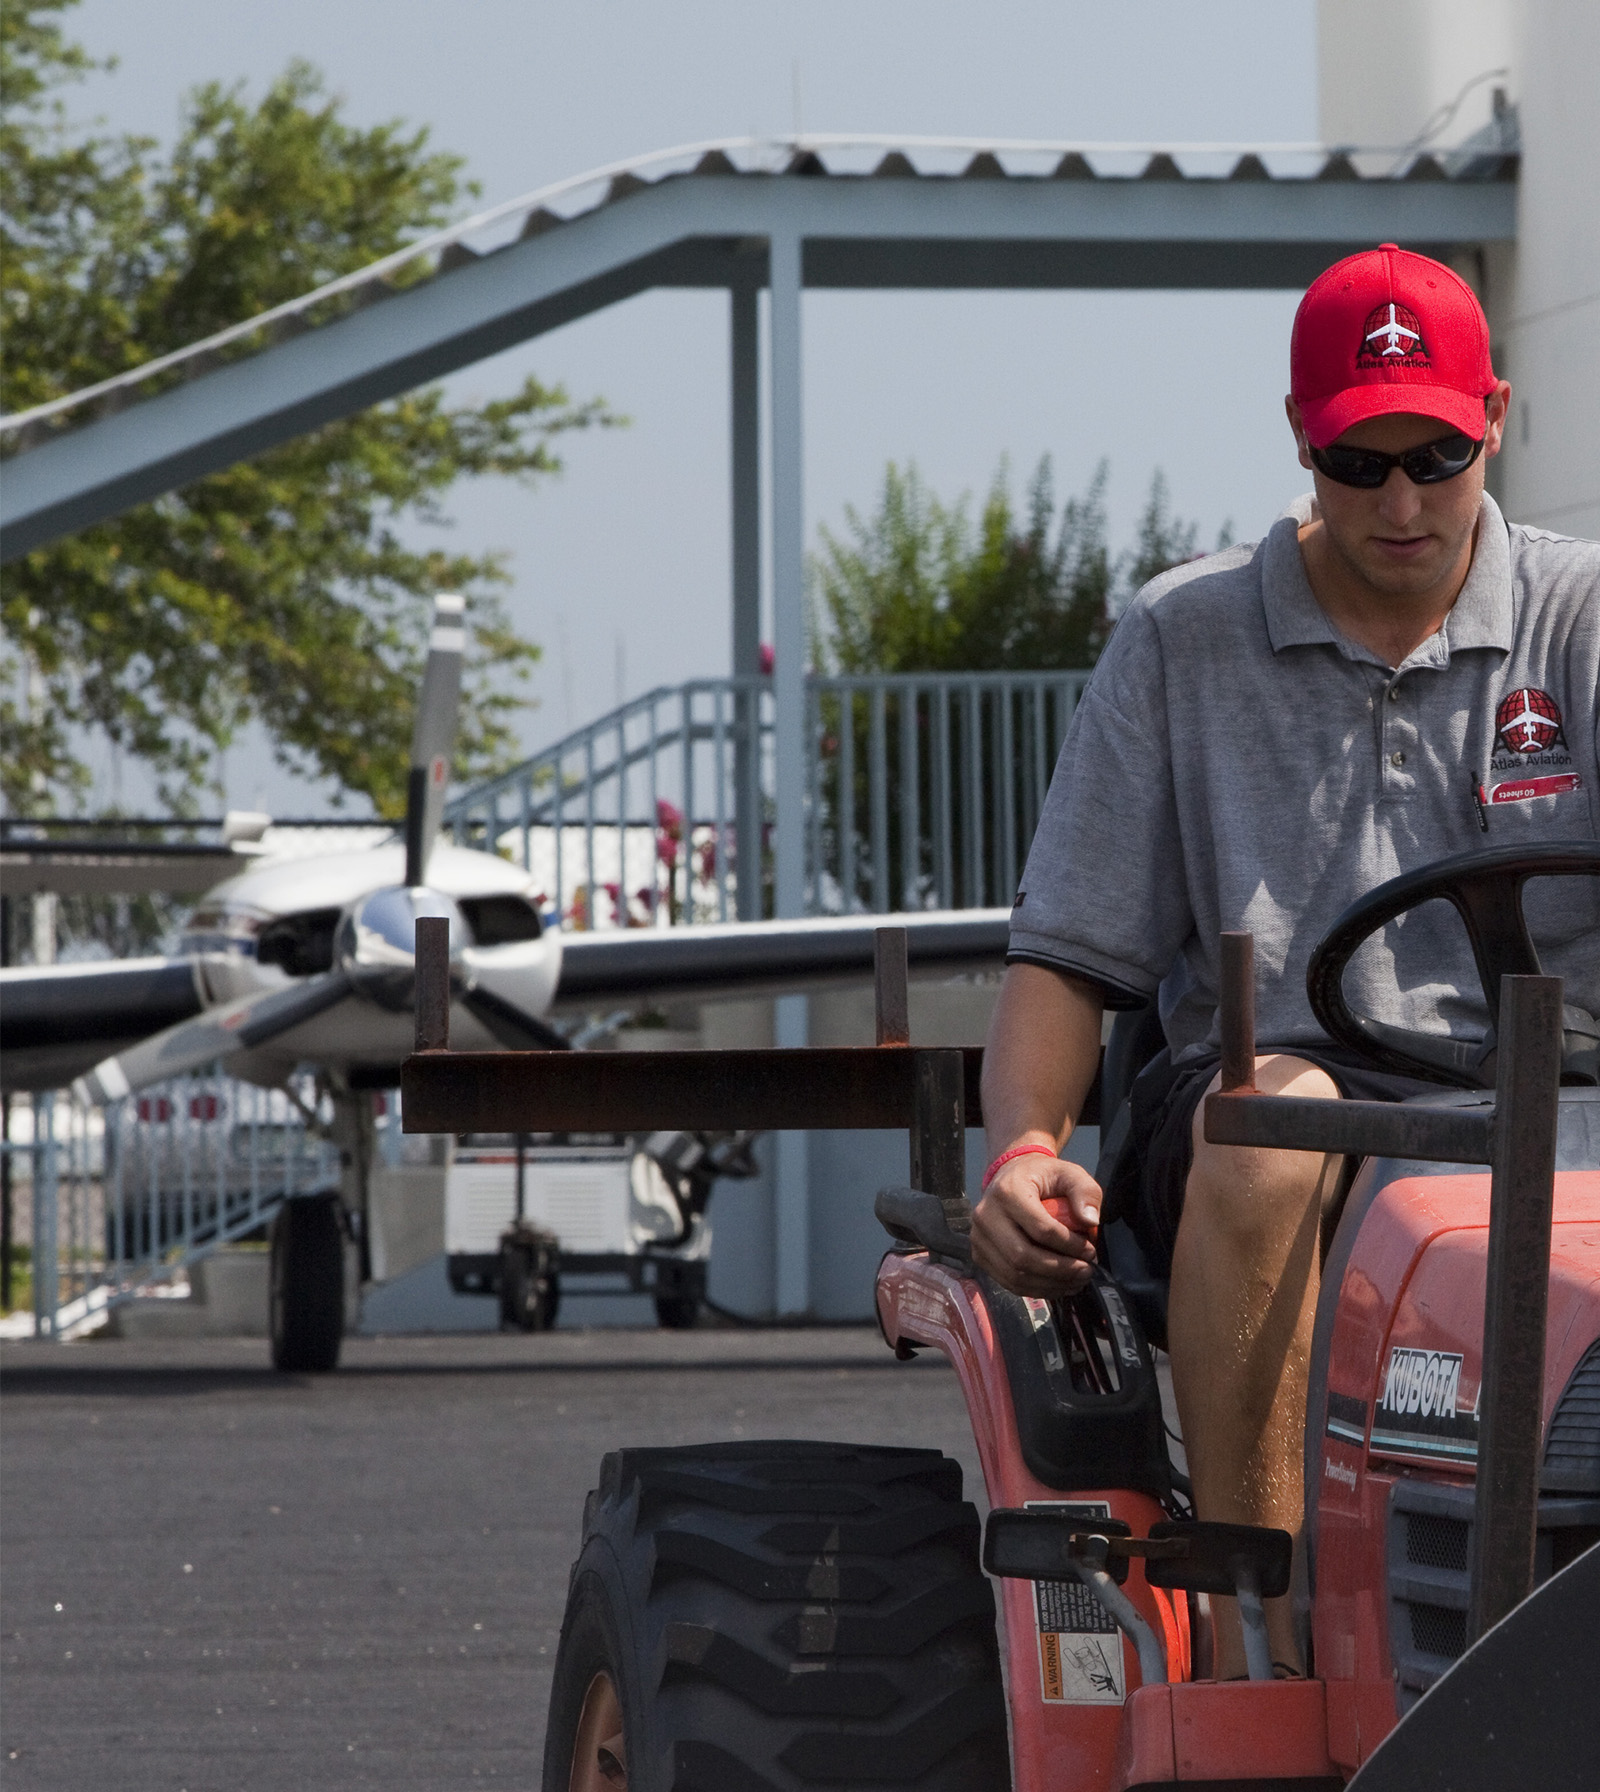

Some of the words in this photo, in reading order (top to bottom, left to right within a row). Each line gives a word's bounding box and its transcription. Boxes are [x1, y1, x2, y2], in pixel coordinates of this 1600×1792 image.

[1387, 358, 1432, 369] Aviation
[1490, 757, 1522, 771] Atlas
[1526, 752, 1572, 766] Aviation
[1498, 789, 1524, 799] sheets
[1524, 788, 1535, 797] 60
[1383, 1352, 1461, 1418] KUBOTA
[1048, 1634, 1057, 1684] WARNING
